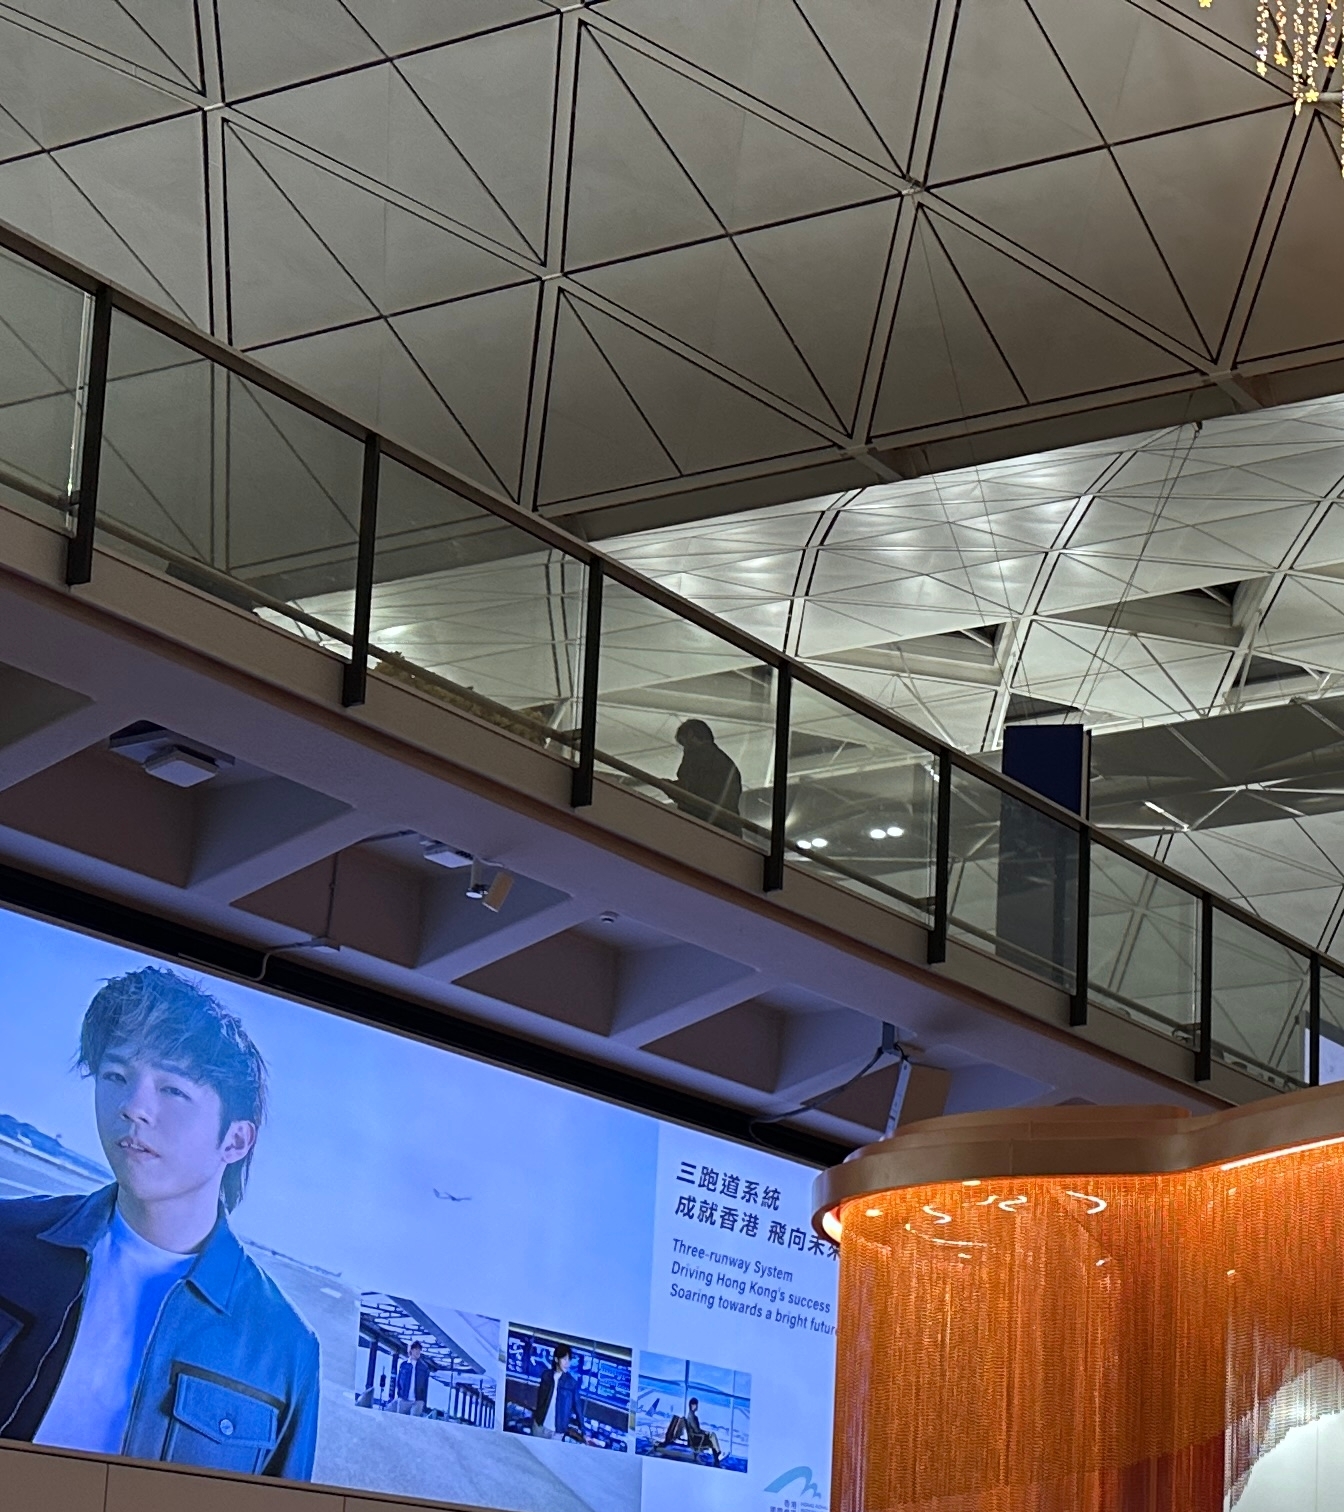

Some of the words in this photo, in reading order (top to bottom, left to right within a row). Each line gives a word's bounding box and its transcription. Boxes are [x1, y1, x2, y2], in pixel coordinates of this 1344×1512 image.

[676, 1161, 782, 1211] 三跑道系統
[675, 1194, 760, 1238] 成就香港
[672, 1238, 751, 1273] Three-runway
[753, 1260, 793, 1282] System
[669, 1283, 715, 1309] Soaring
[718, 1295, 762, 1318] towards
[765, 1309, 772, 1320] a
[775, 1308, 807, 1329] bright
[810, 1317, 838, 1336] futur
[671, 1260, 714, 1286] Driving
[716, 1272, 746, 1295] Hong
[749, 1281, 785, 1302] Kong's
[788, 1292, 831, 1314] success
